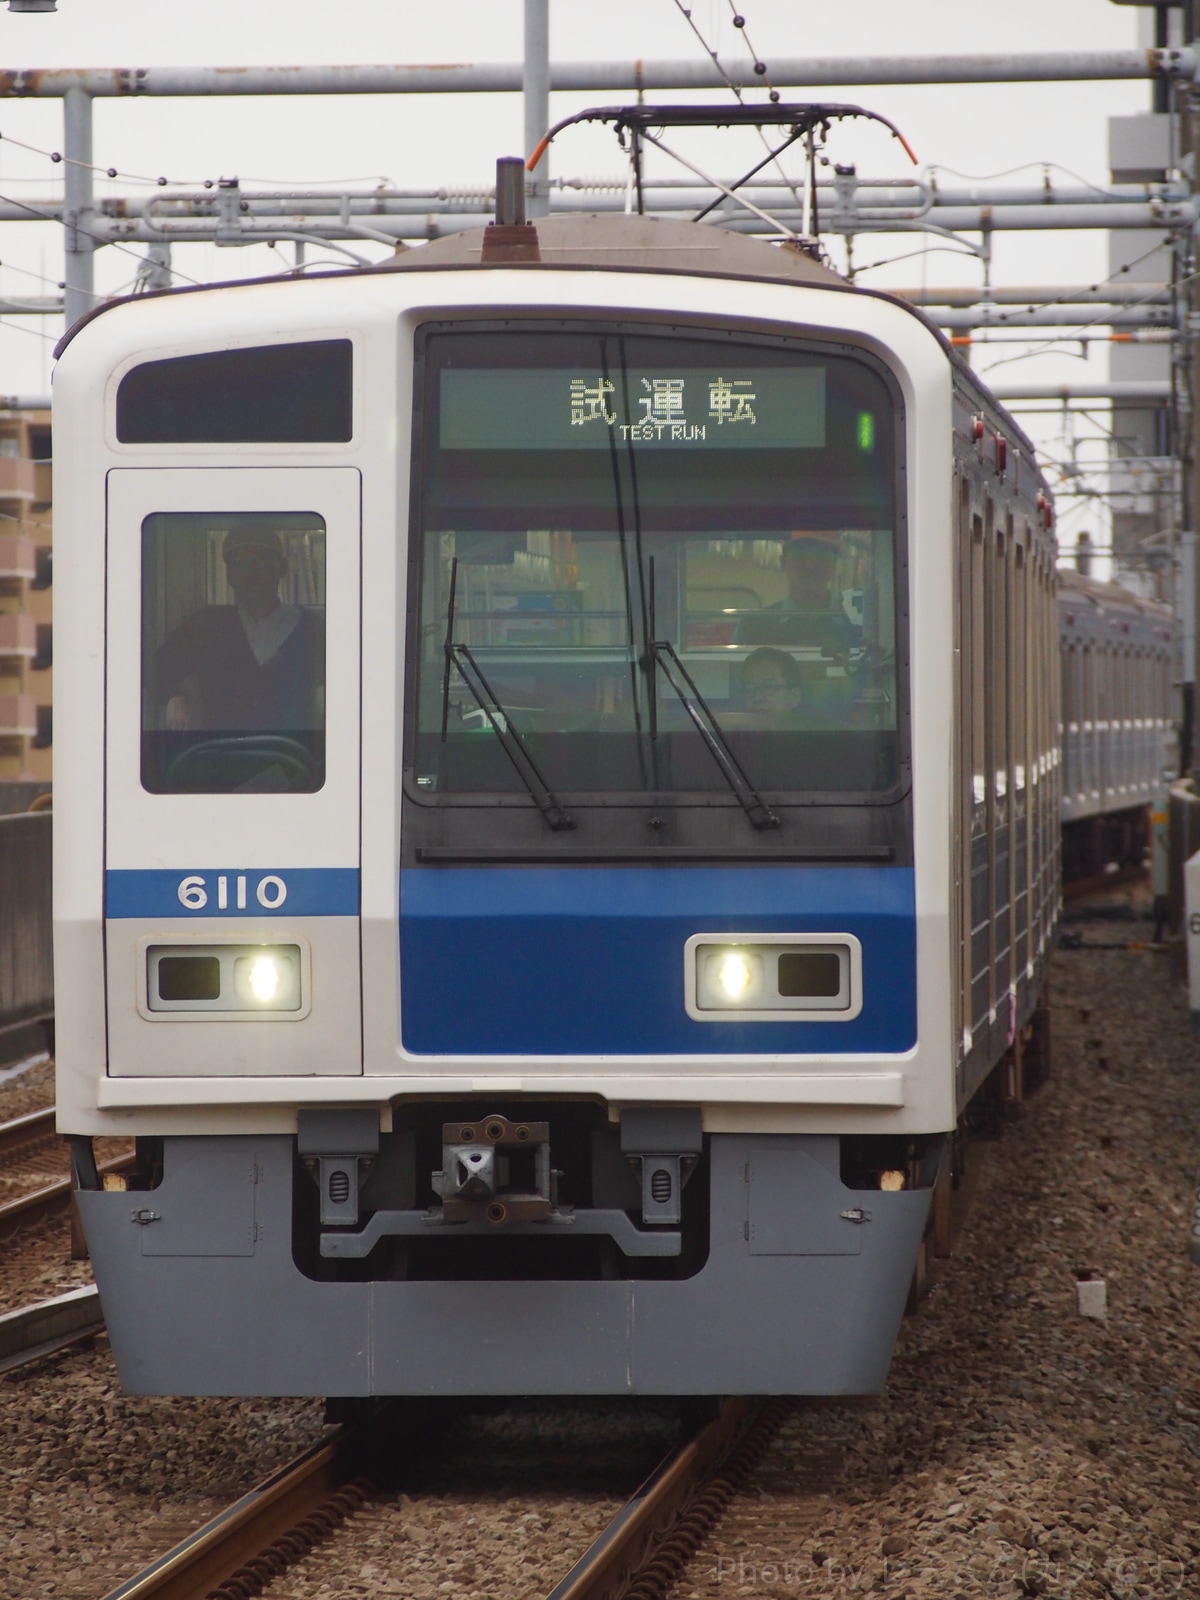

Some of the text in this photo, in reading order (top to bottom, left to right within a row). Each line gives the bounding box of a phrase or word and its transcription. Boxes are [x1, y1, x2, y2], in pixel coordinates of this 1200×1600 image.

[569, 377, 756, 424] 試運転
[619, 424, 706, 440] TEST RUN
[177, 875, 288, 910] 6110
